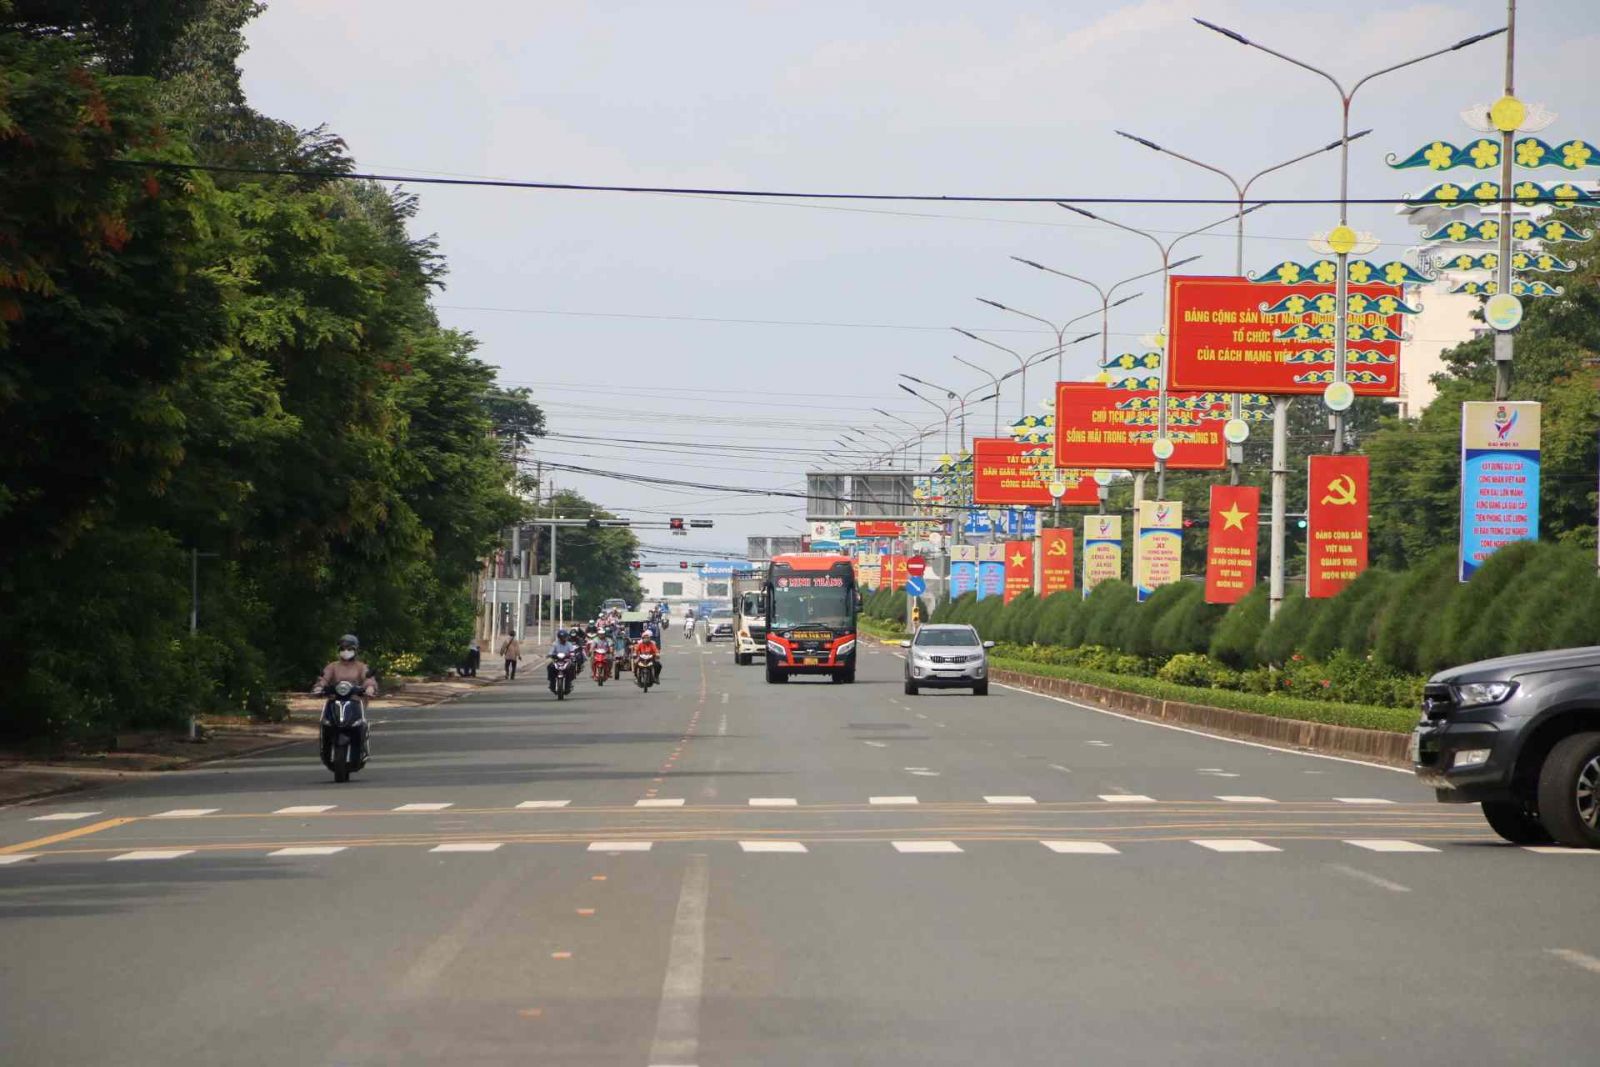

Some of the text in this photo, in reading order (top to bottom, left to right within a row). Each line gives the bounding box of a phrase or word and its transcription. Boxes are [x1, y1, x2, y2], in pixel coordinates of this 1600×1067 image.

[1184, 306, 1210, 322] ĐẢNG
[1212, 308, 1237, 325] CỘNG
[1239, 307, 1258, 323] SẢN
[1232, 326, 1245, 342] TỔ
[1246, 328, 1271, 343] CHỨC
[1197, 345, 1216, 360] CỦA
[1218, 347, 1242, 361] CÁCH
[1244, 350, 1272, 364] MẠNG
